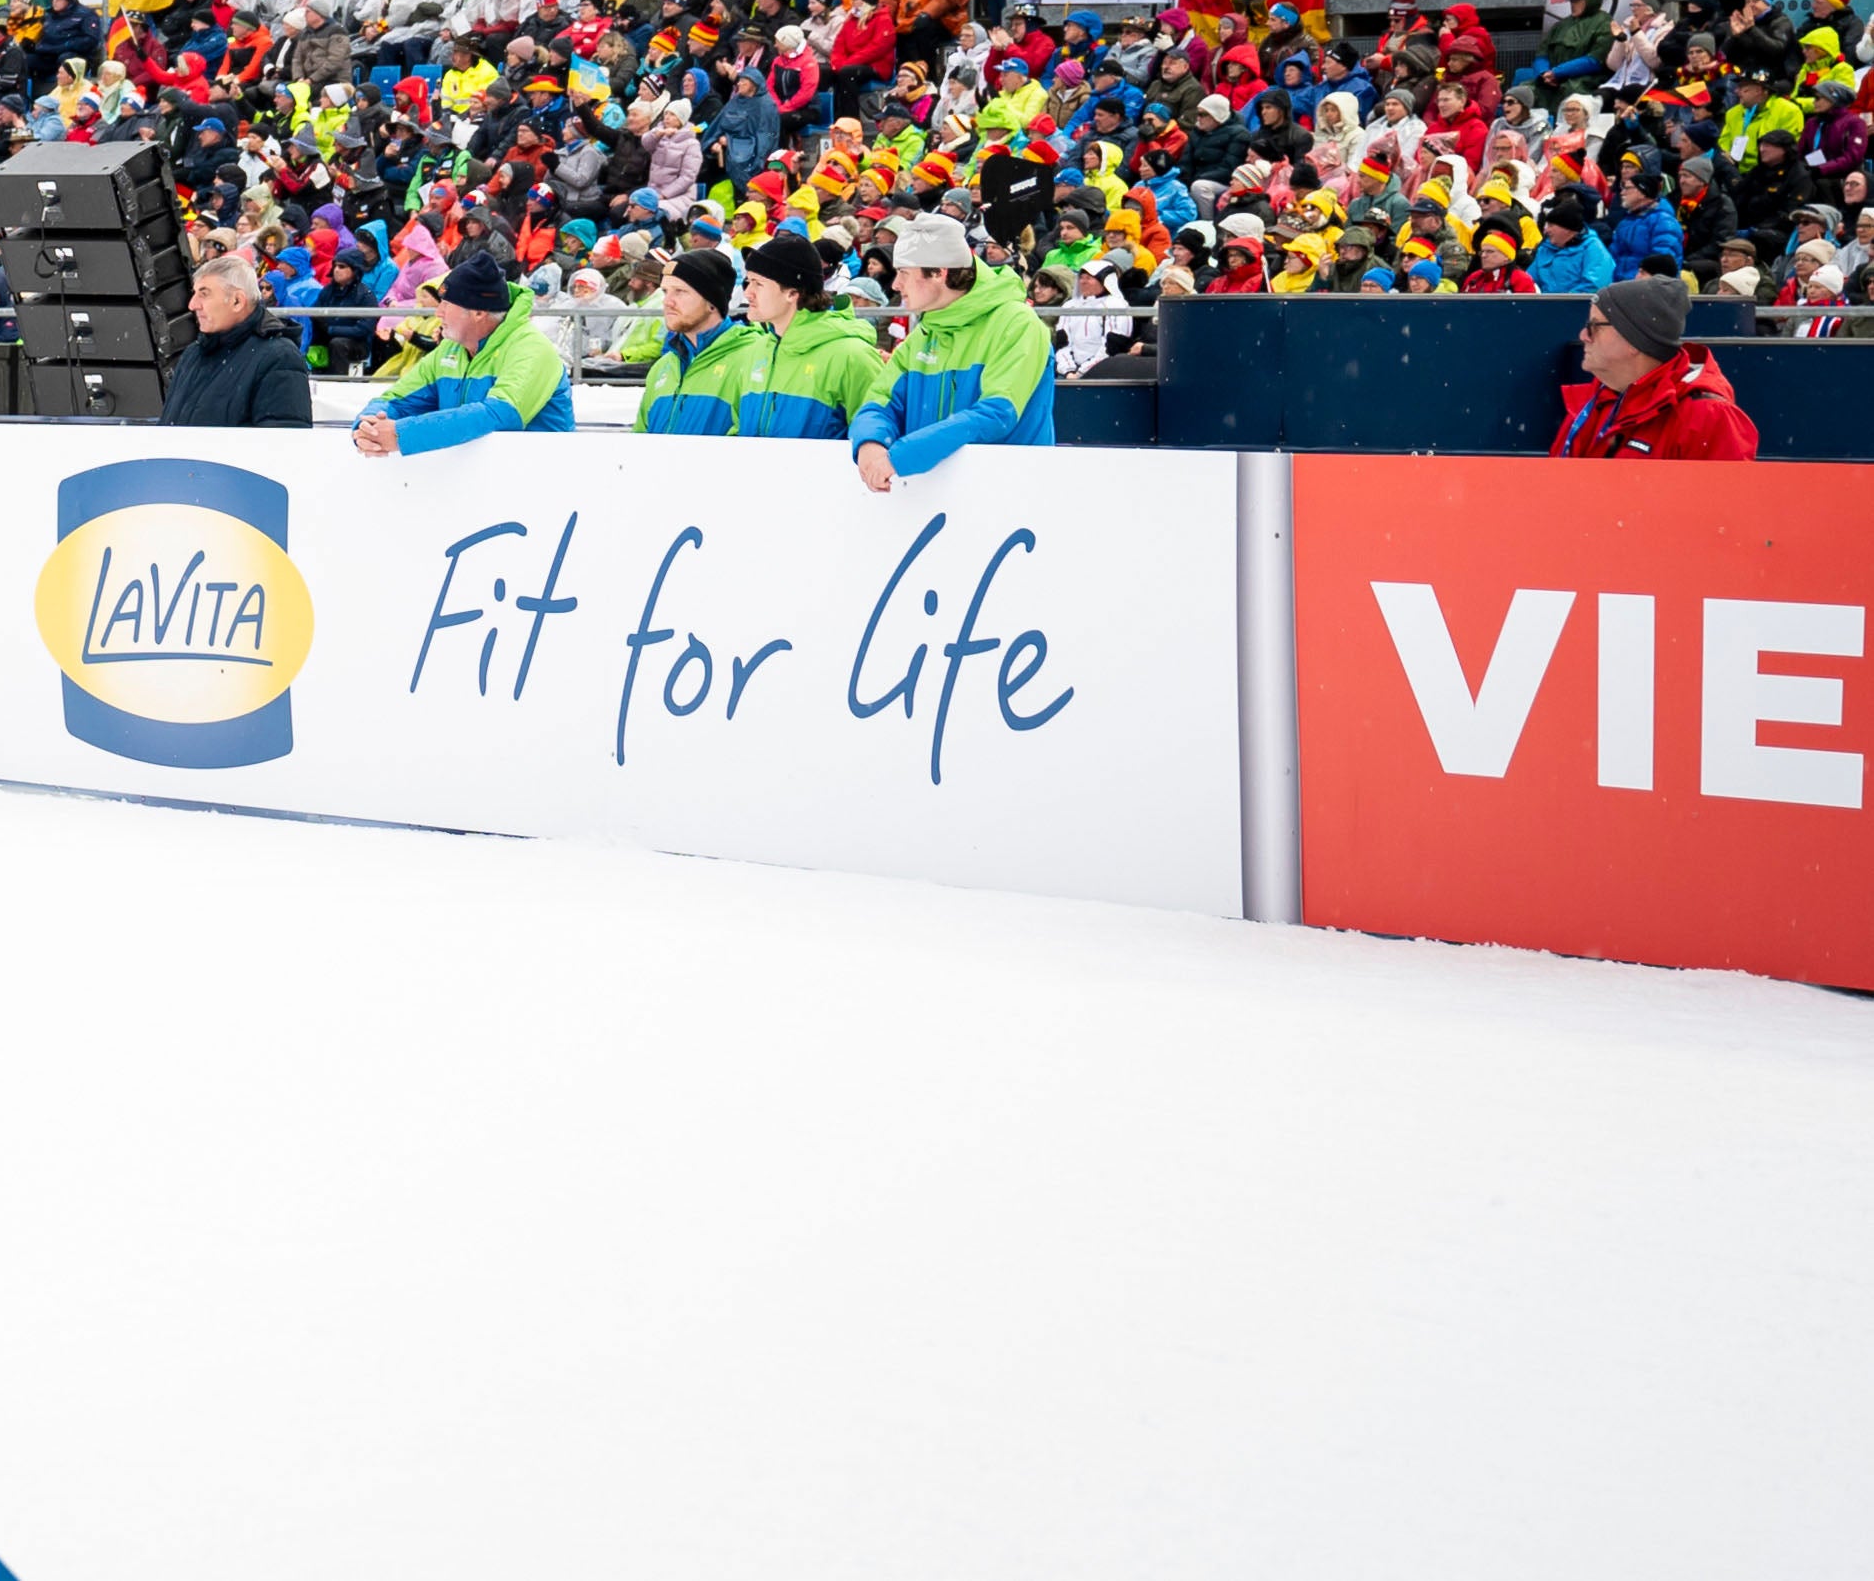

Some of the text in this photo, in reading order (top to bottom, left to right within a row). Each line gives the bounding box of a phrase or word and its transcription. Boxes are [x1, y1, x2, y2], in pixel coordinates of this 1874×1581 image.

[409, 510, 579, 701] Fit
[616, 526, 793, 766] for
[1369, 581, 1865, 809] VIE
